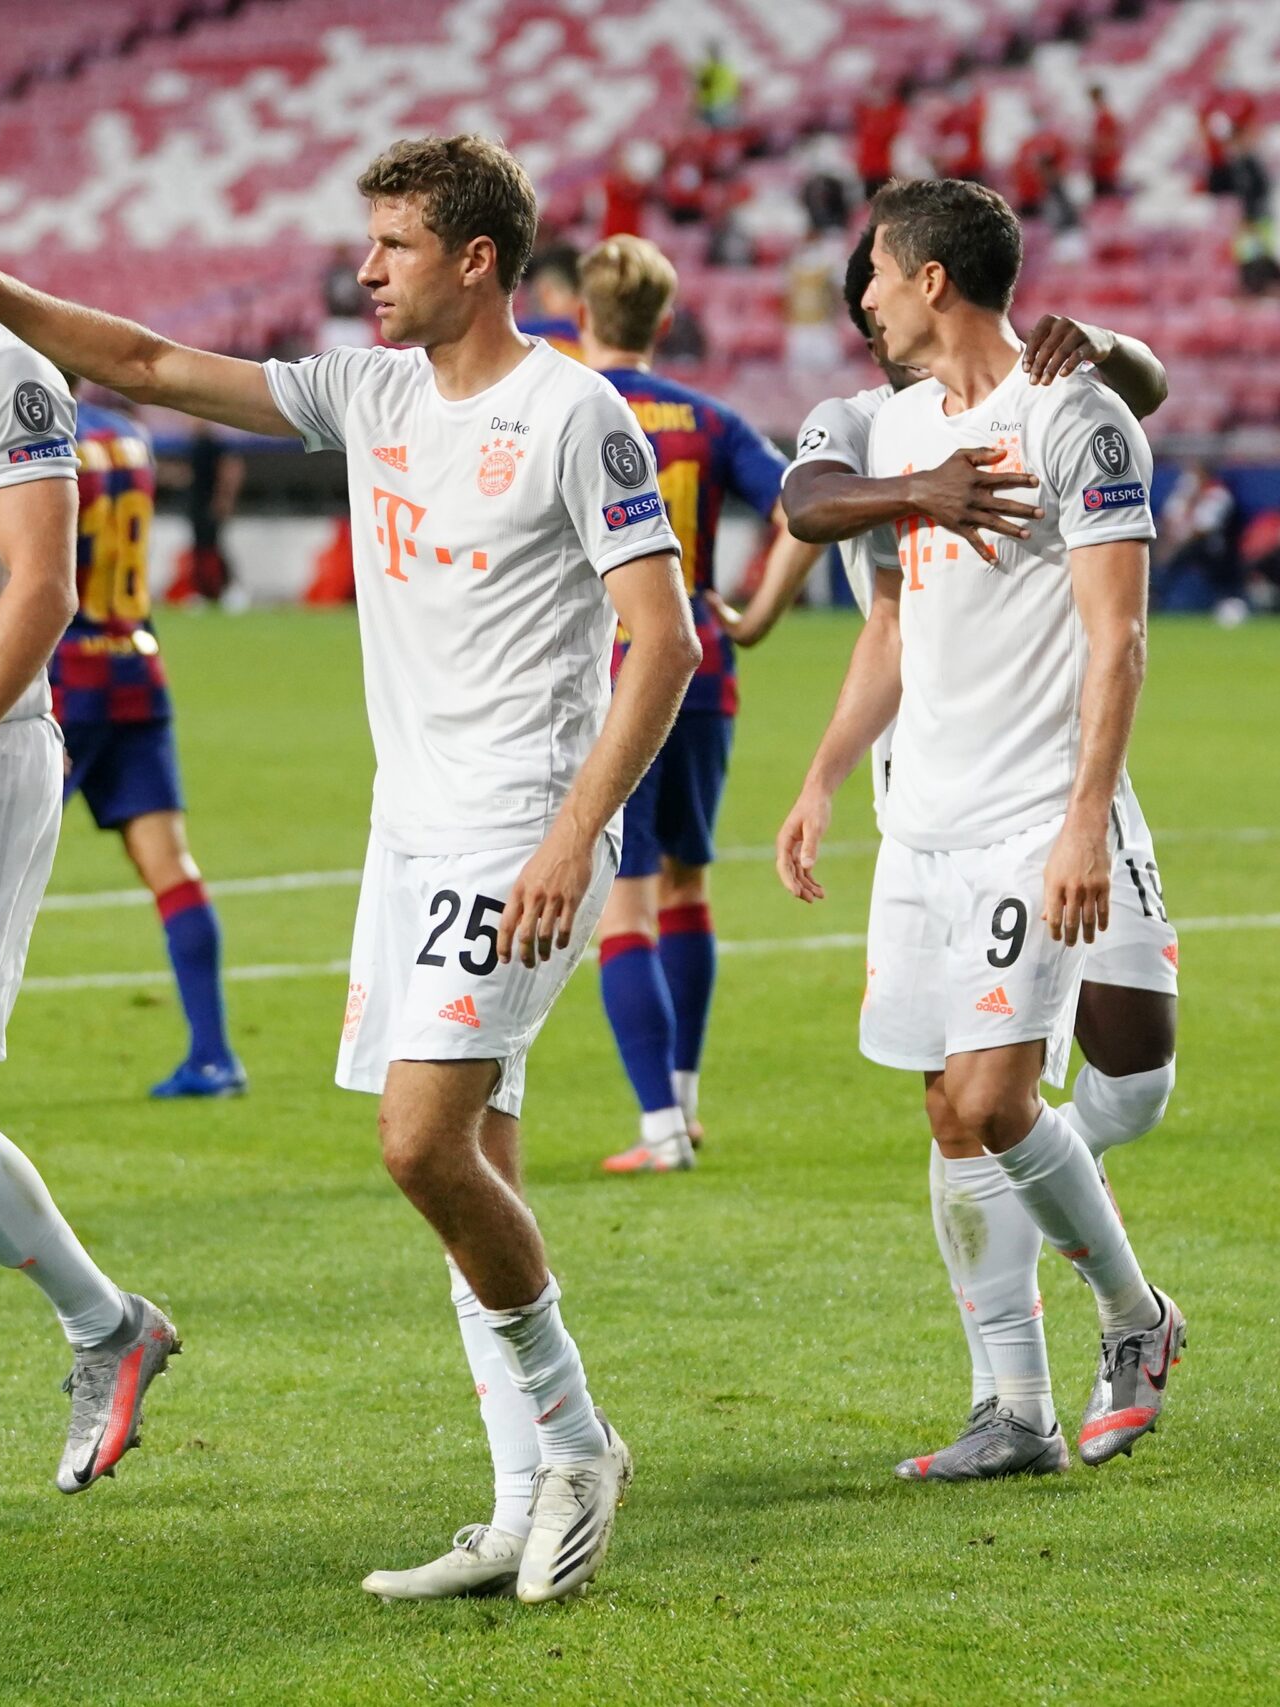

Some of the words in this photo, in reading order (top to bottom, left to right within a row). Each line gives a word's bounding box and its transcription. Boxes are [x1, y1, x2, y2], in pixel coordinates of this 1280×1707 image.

[32, 405, 42, 420] 5
[491, 416, 530, 435] Danke
[1109, 448, 1119, 463] 5
[623, 458, 633, 473] 5
[80, 490, 153, 623] 18
[416, 889, 507, 976] 25
[986, 897, 1027, 968] 9
[975, 1001, 1014, 1015] adidas
[438, 1009, 481, 1028] adidas
